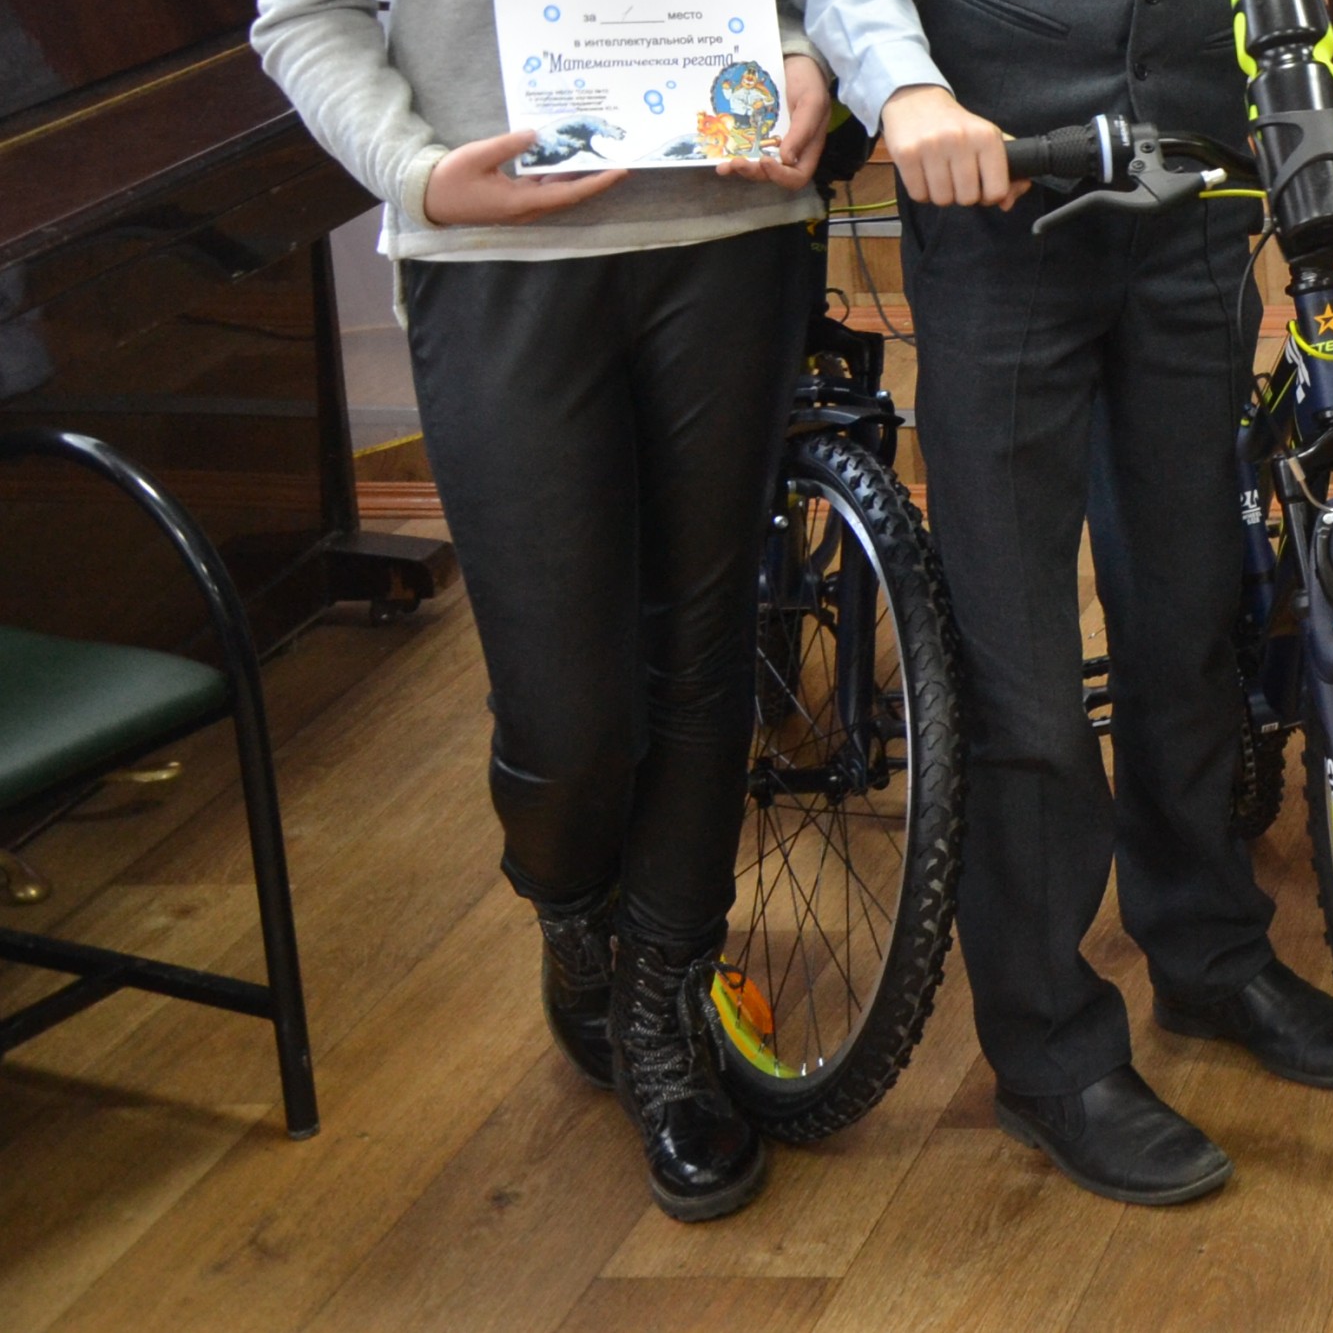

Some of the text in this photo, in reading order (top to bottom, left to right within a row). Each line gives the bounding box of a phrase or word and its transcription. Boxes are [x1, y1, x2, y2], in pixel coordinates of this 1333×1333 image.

[583, 14, 597, 23] за
[668, 11, 702, 21] место
[574, 35, 723, 48] в интеллектуальной игре
[543, 50, 679, 73] "Математическая
